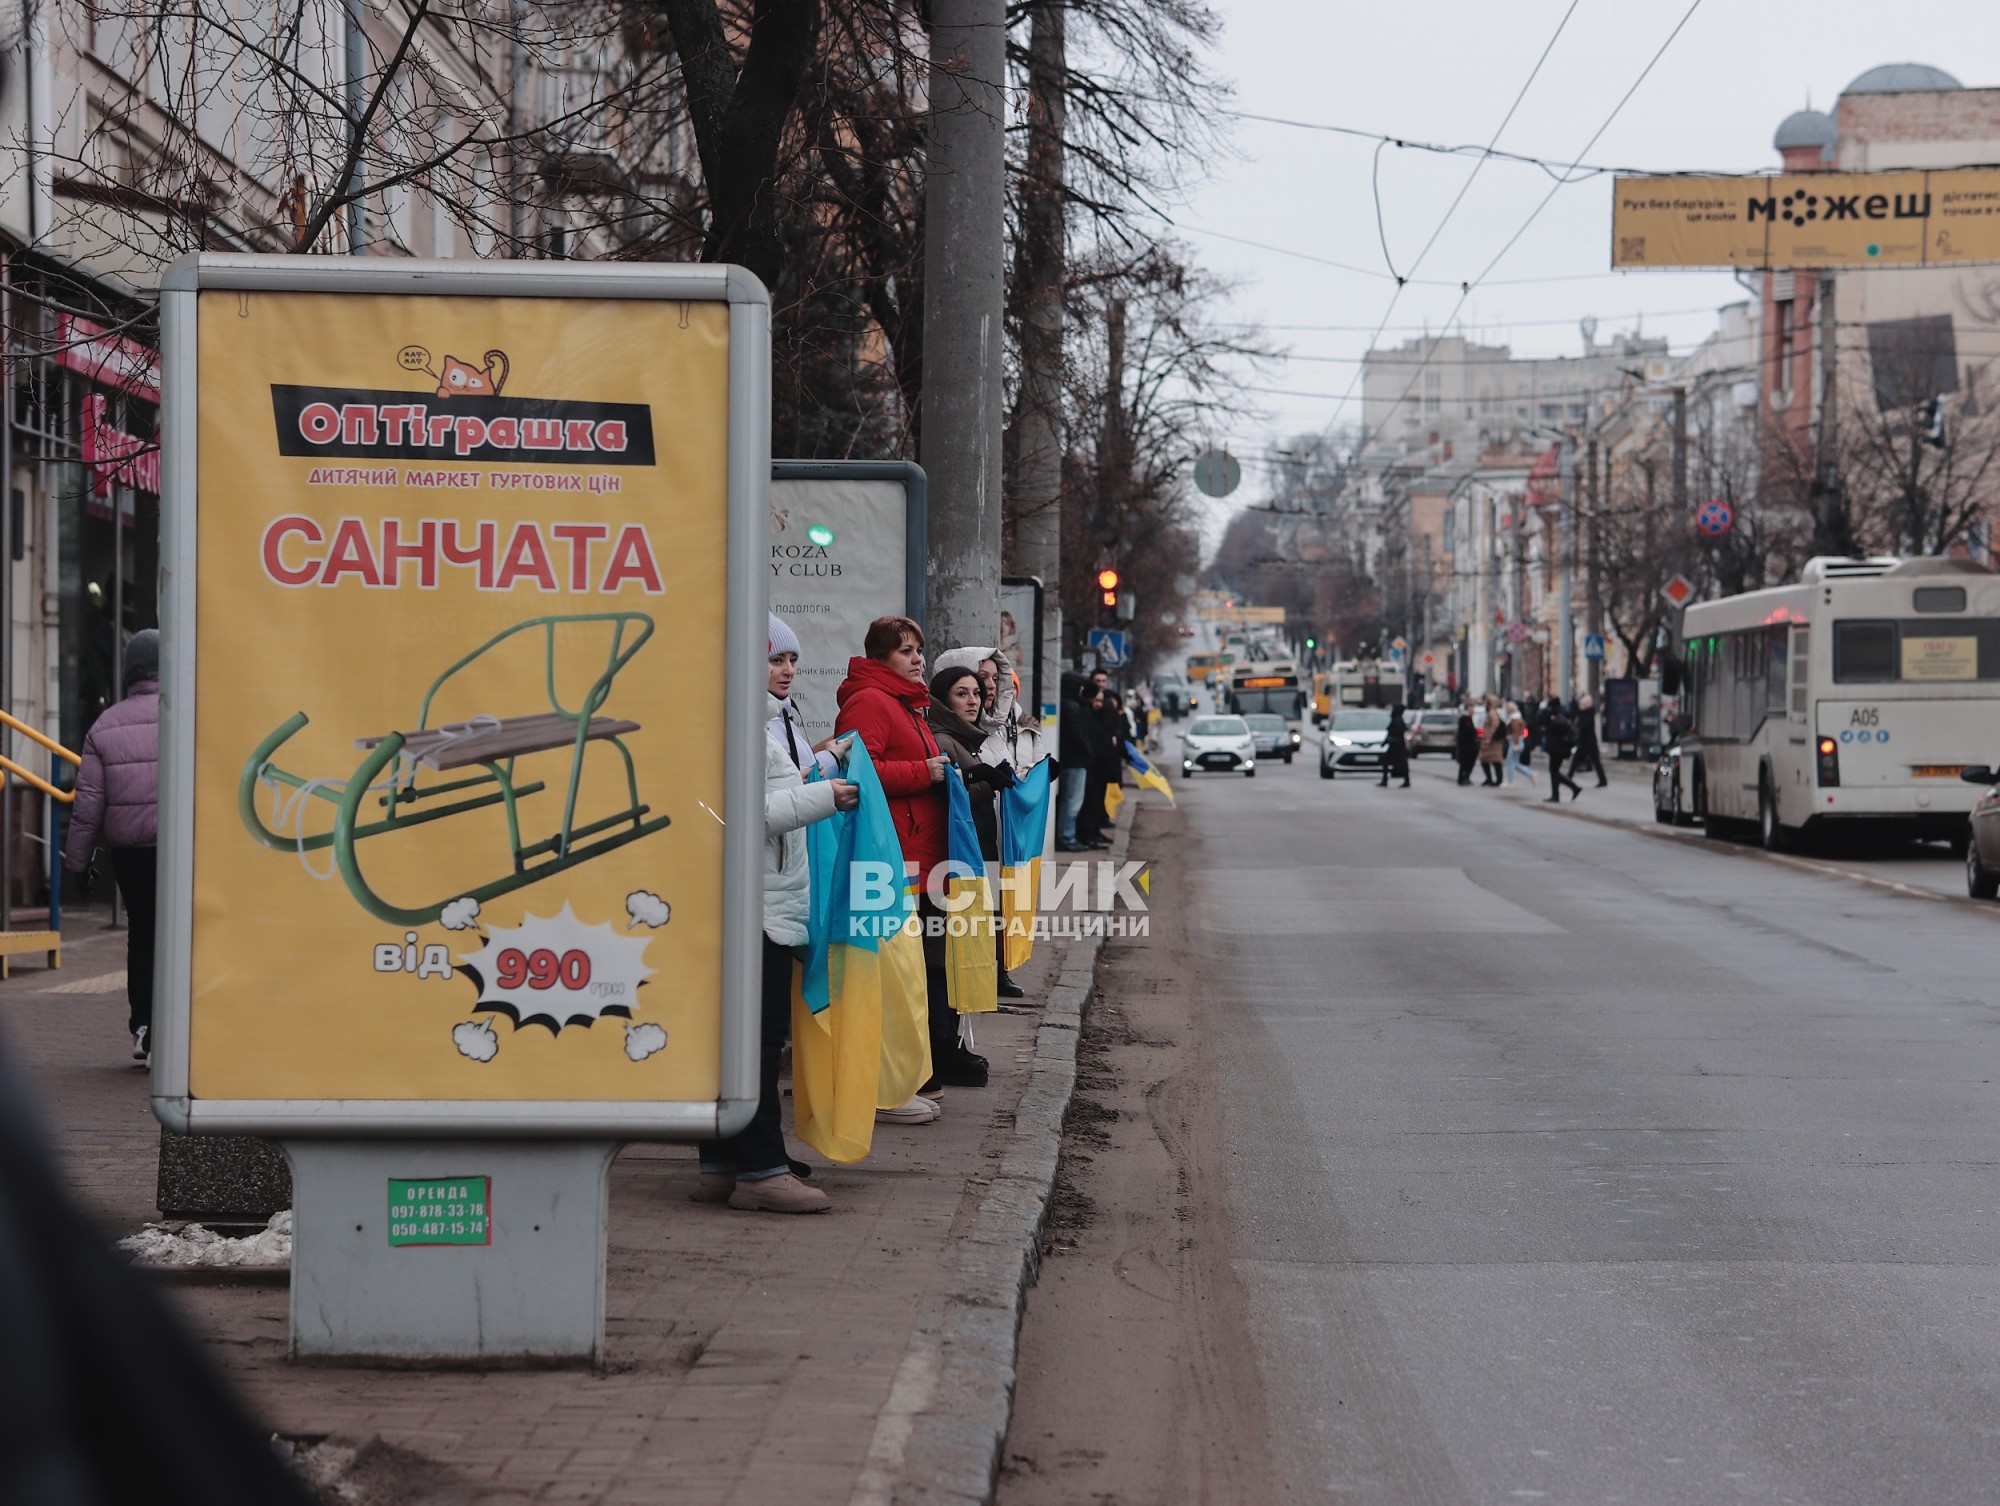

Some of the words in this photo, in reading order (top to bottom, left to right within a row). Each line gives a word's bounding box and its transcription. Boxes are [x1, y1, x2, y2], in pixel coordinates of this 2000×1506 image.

[308, 467, 397, 486] ДИТЯЧИЙ
[406, 470, 480, 488] МАРКЕТ
[490, 471, 582, 491] ГУРТОВИХ
[261, 514, 665, 595] САНЧАТА
[771, 545, 829, 559] KOZA
[771, 563, 783, 577] Y
[789, 563, 843, 577] CLUB
[775, 604, 831, 614] ПОДОЛОГІЯ
[796, 668, 818, 676] ДНИХ
[819, 667, 847, 676] ВИПАД
[373, 931, 453, 980] від
[496, 948, 592, 990] 990
[590, 982, 624, 998] грн
[407, 1186, 468, 1200] ОРЕНДА
[391, 1203, 483, 1219] 097-878-33-78
[392, 1221, 483, 1236] 050-487-15-74
